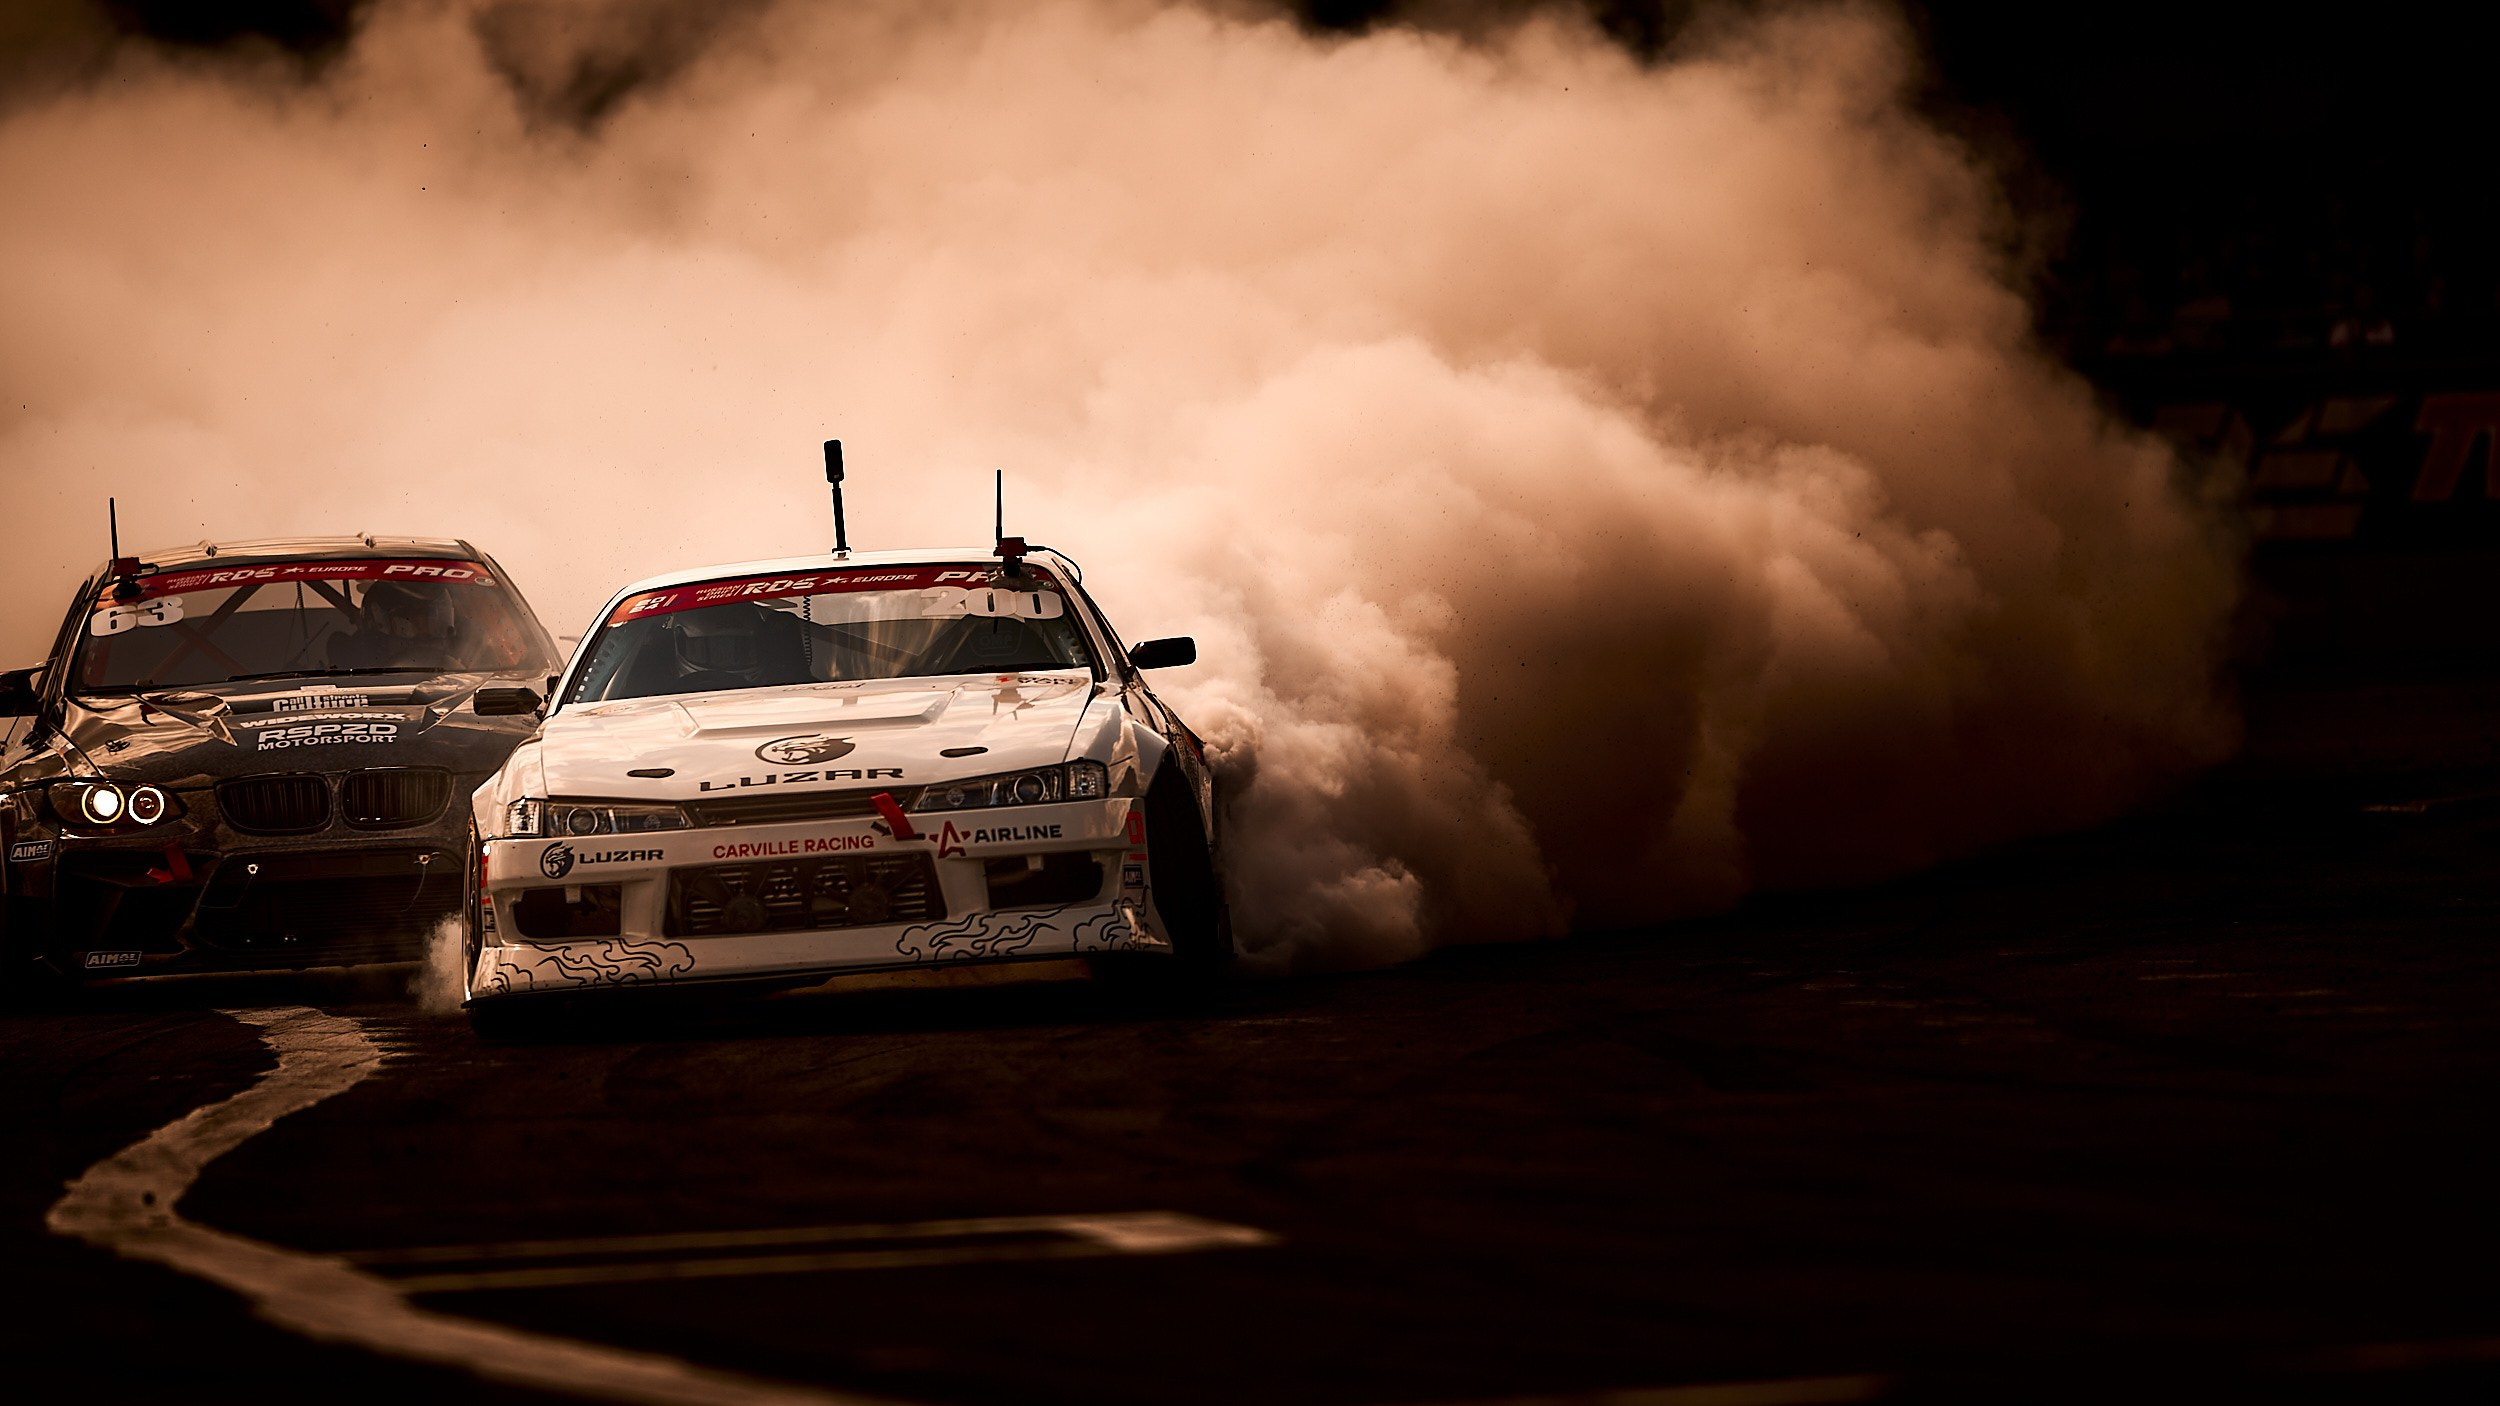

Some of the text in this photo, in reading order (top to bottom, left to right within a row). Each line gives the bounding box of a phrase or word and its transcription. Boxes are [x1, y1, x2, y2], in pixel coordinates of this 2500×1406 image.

[209, 567, 279, 583] RDS
[383, 564, 474, 578] PRO
[742, 576, 820, 595] RDS
[855, 574, 918, 582] EUROPE
[920, 586, 1064, 620] 200
[91, 596, 184, 637] 63
[240, 713, 407, 728] WIDEWORX
[257, 735, 397, 751] MOTORSPORT
[258, 723, 398, 742] RSPZD
[700, 768, 904, 792] LUZAR
[974, 823, 1063, 844] AIRLINE
[579, 849, 664, 864] LUZAR
[713, 835, 874, 859] CARVILLE RACING
